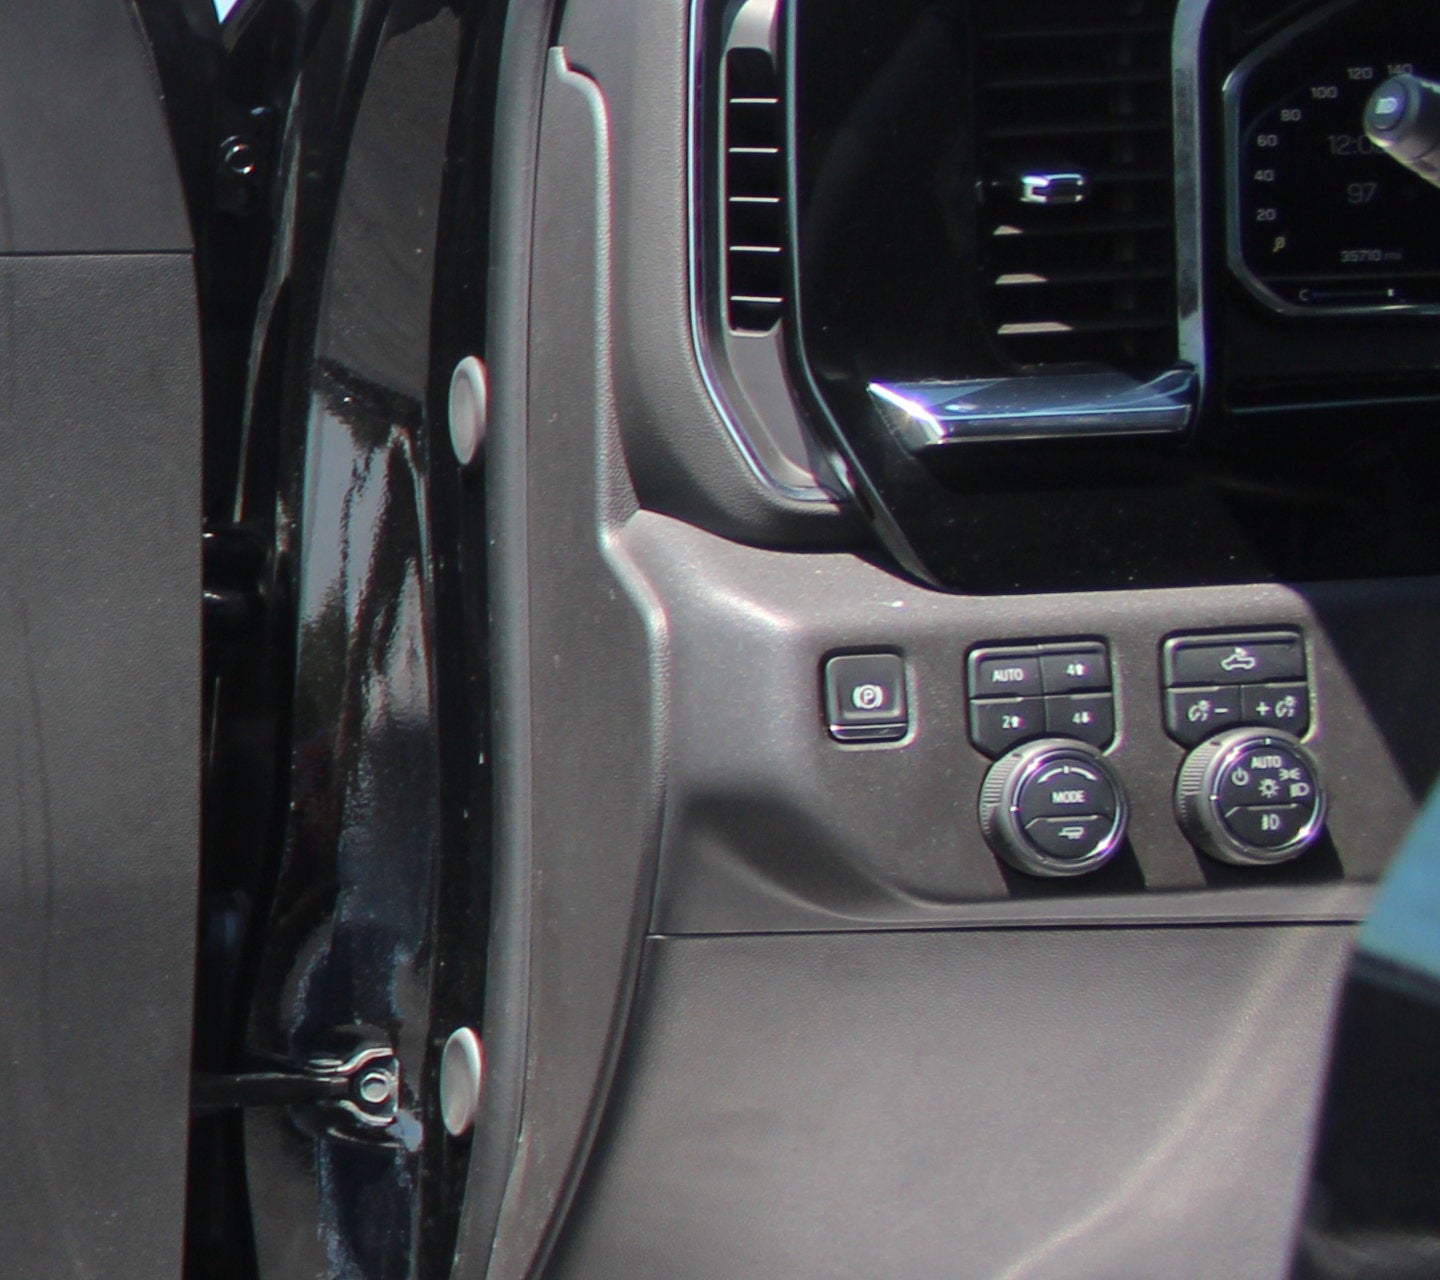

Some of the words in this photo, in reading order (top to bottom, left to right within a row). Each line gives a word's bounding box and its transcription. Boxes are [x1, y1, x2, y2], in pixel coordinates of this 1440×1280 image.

[1347, 67, 1374, 80] 120
[1311, 86, 1339, 99] 100
[1280, 109, 1302, 122] 80
[1257, 134, 1278, 147] 60
[1254, 169, 1275, 182] 40
[1347, 182, 1378, 204] 97
[1256, 208, 1277, 221] 20
[992, 668, 1024, 682] AUTO
[1250, 755, 1282, 769] AUTO
[1051, 790, 1086, 804] MODE
